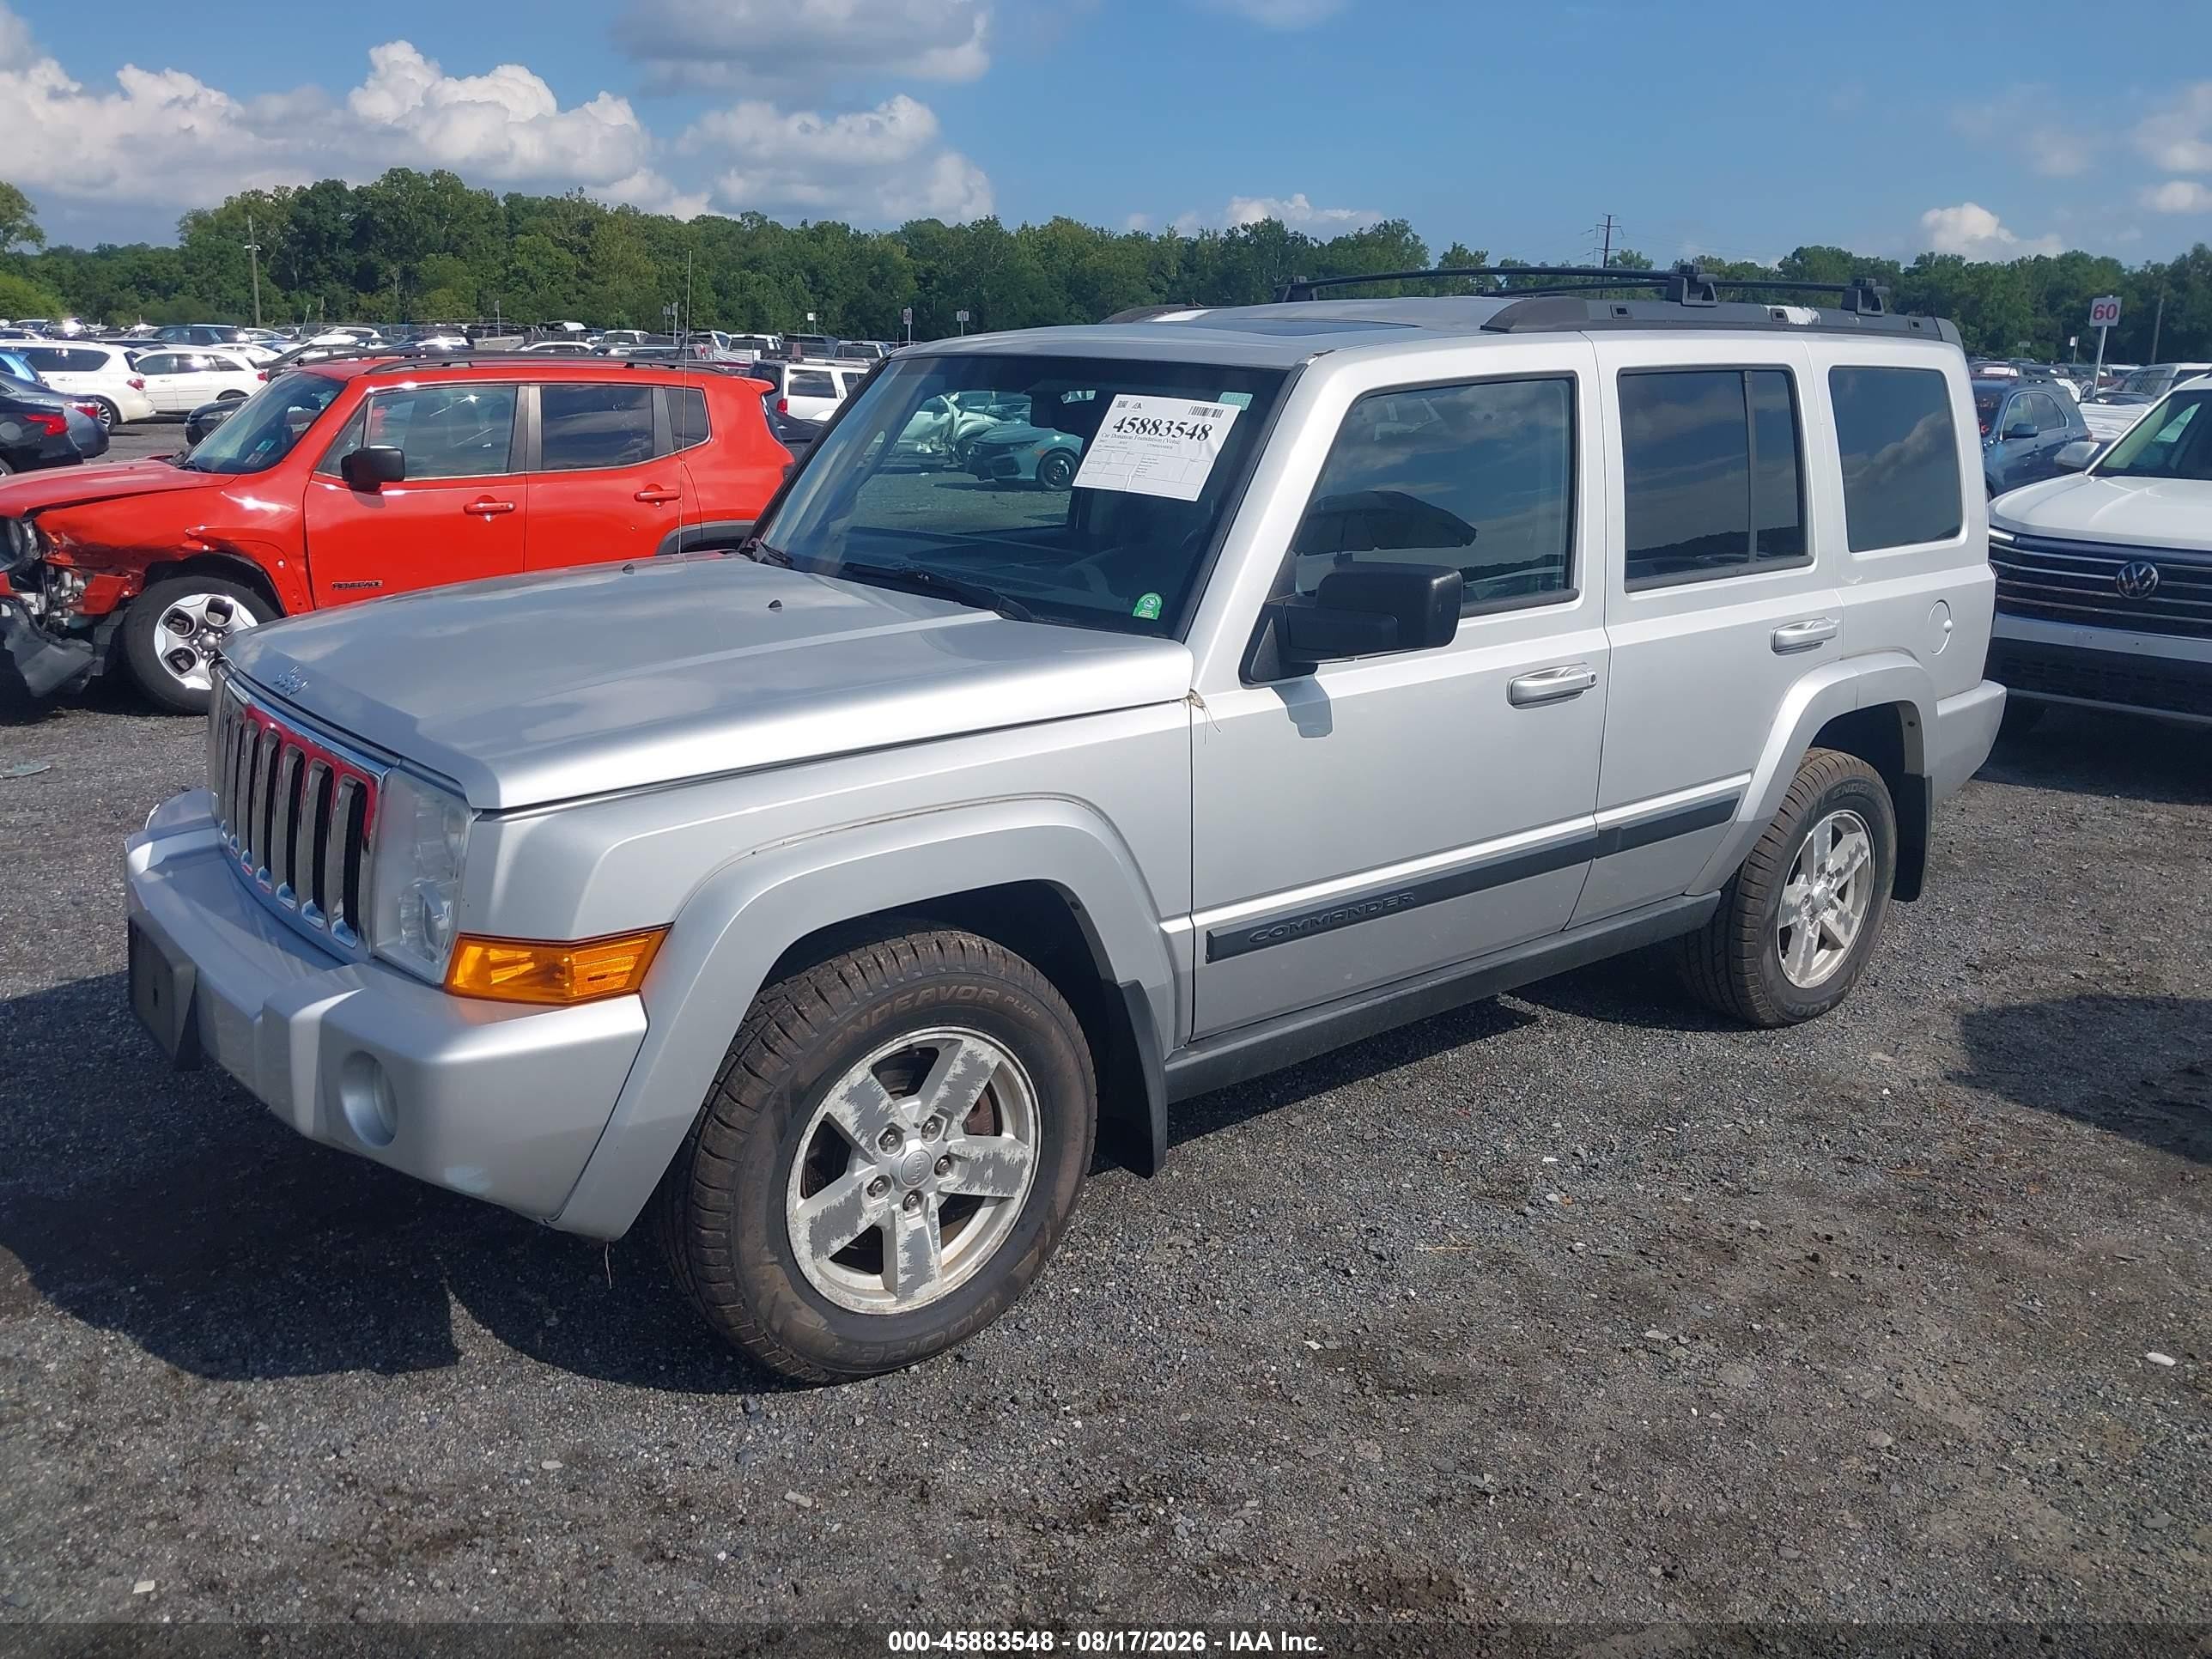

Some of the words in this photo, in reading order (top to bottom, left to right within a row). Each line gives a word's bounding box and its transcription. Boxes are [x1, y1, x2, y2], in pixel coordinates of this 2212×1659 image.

[2093, 303, 2118, 320] 60
[1113, 416, 1213, 441] 45883548
[1133, 434, 1163, 443] Foundation
[1249, 892, 1415, 943] COMMANDER
[825, 985, 1000, 1054] ENDEAVOR
[1003, 995, 1040, 1020] PLUS
